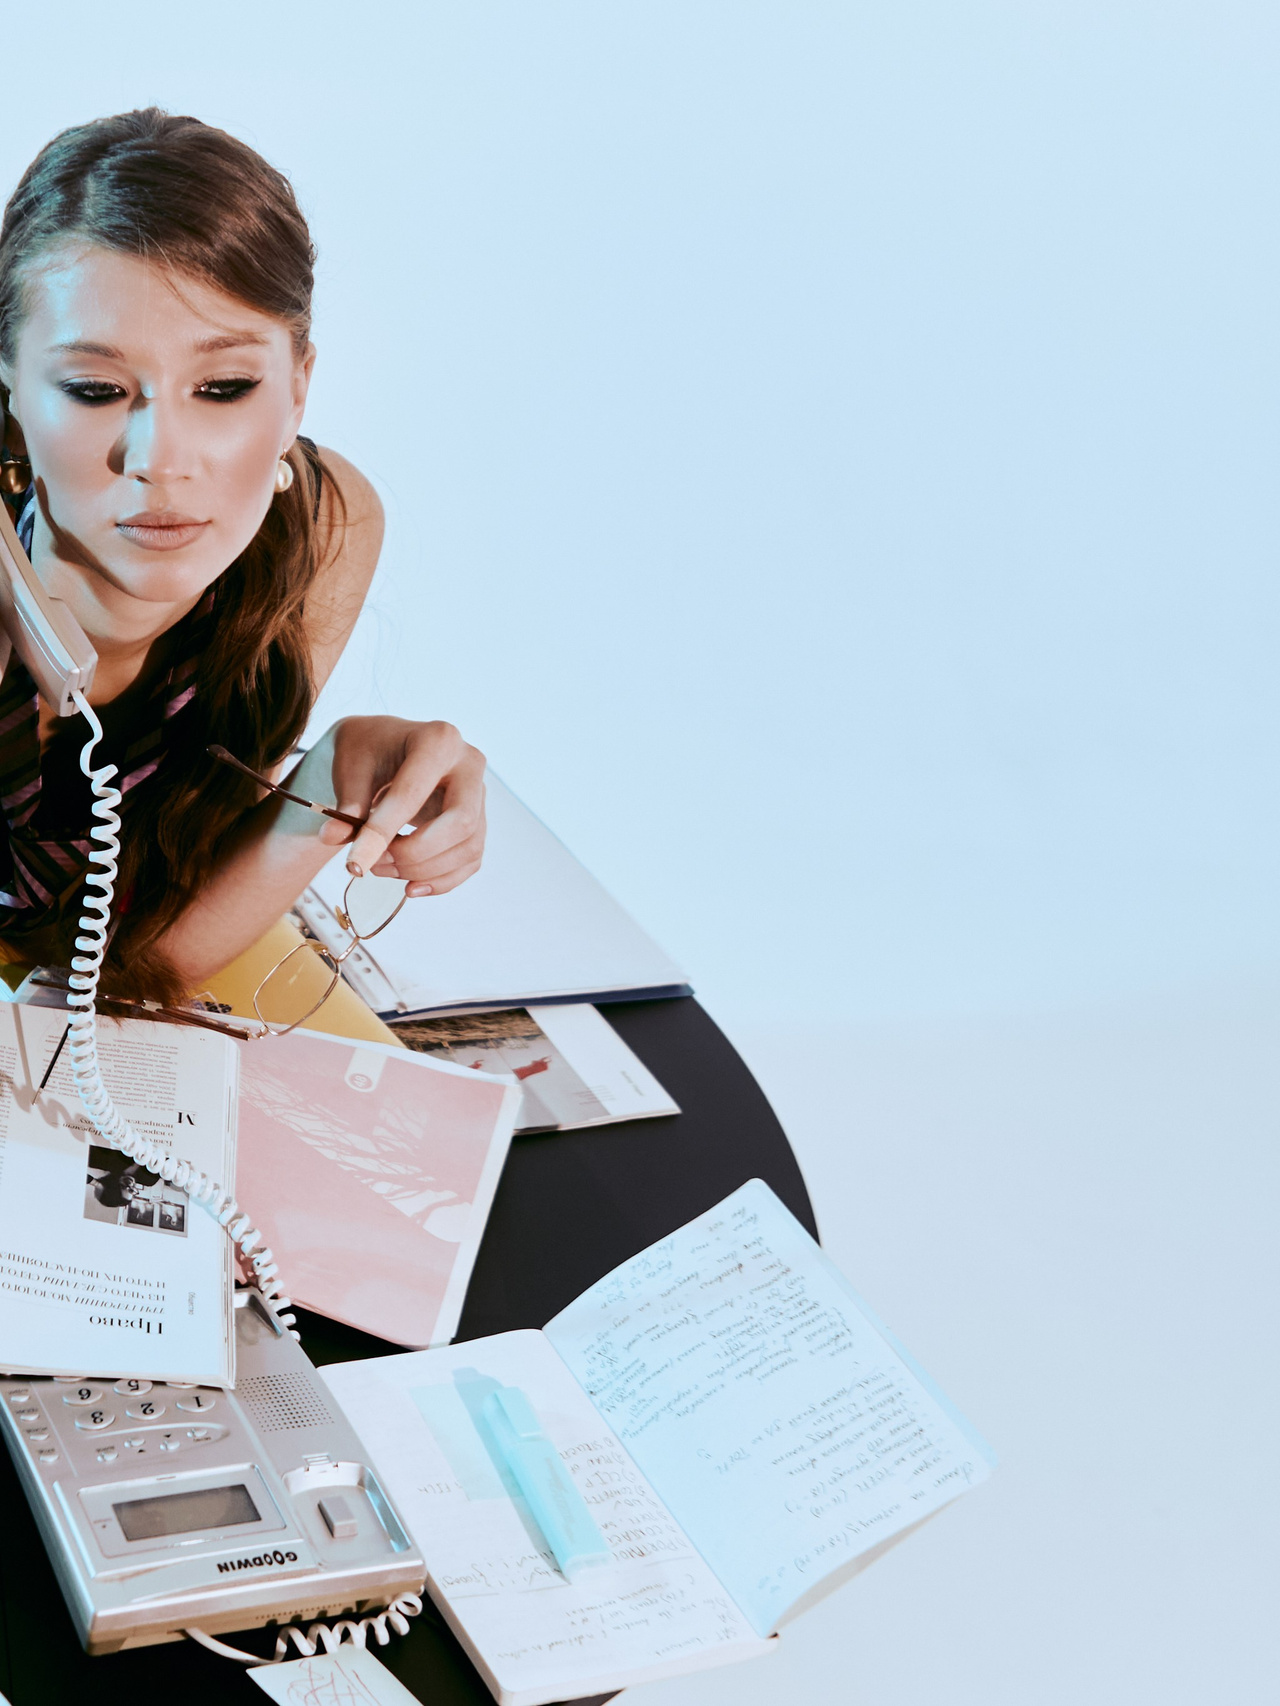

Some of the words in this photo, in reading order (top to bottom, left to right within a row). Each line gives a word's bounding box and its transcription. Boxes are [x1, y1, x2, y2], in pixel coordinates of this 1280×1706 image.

[41, 1275, 108, 1293] СДЕЛАНЫ
[102, 1272, 122, 1282] ИХ
[0, 1280, 71, 1302] МОЛОДОГО
[109, 1288, 144, 1300] ЧЕГО
[147, 1293, 166, 1301] ИЗ
[72, 1296, 137, 1311] ГЕРОИНИ
[139, 1305, 165, 1314] ТРИ
[88, 1313, 164, 1334] Право
[126, 1378, 140, 1392] 5
[76, 1386, 92, 1401] 6
[192, 1394, 204, 1408] 1
[139, 1401, 155, 1416] 2
[89, 1410, 104, 1424] 3
[215, 1549, 298, 1574] GOODWIN
